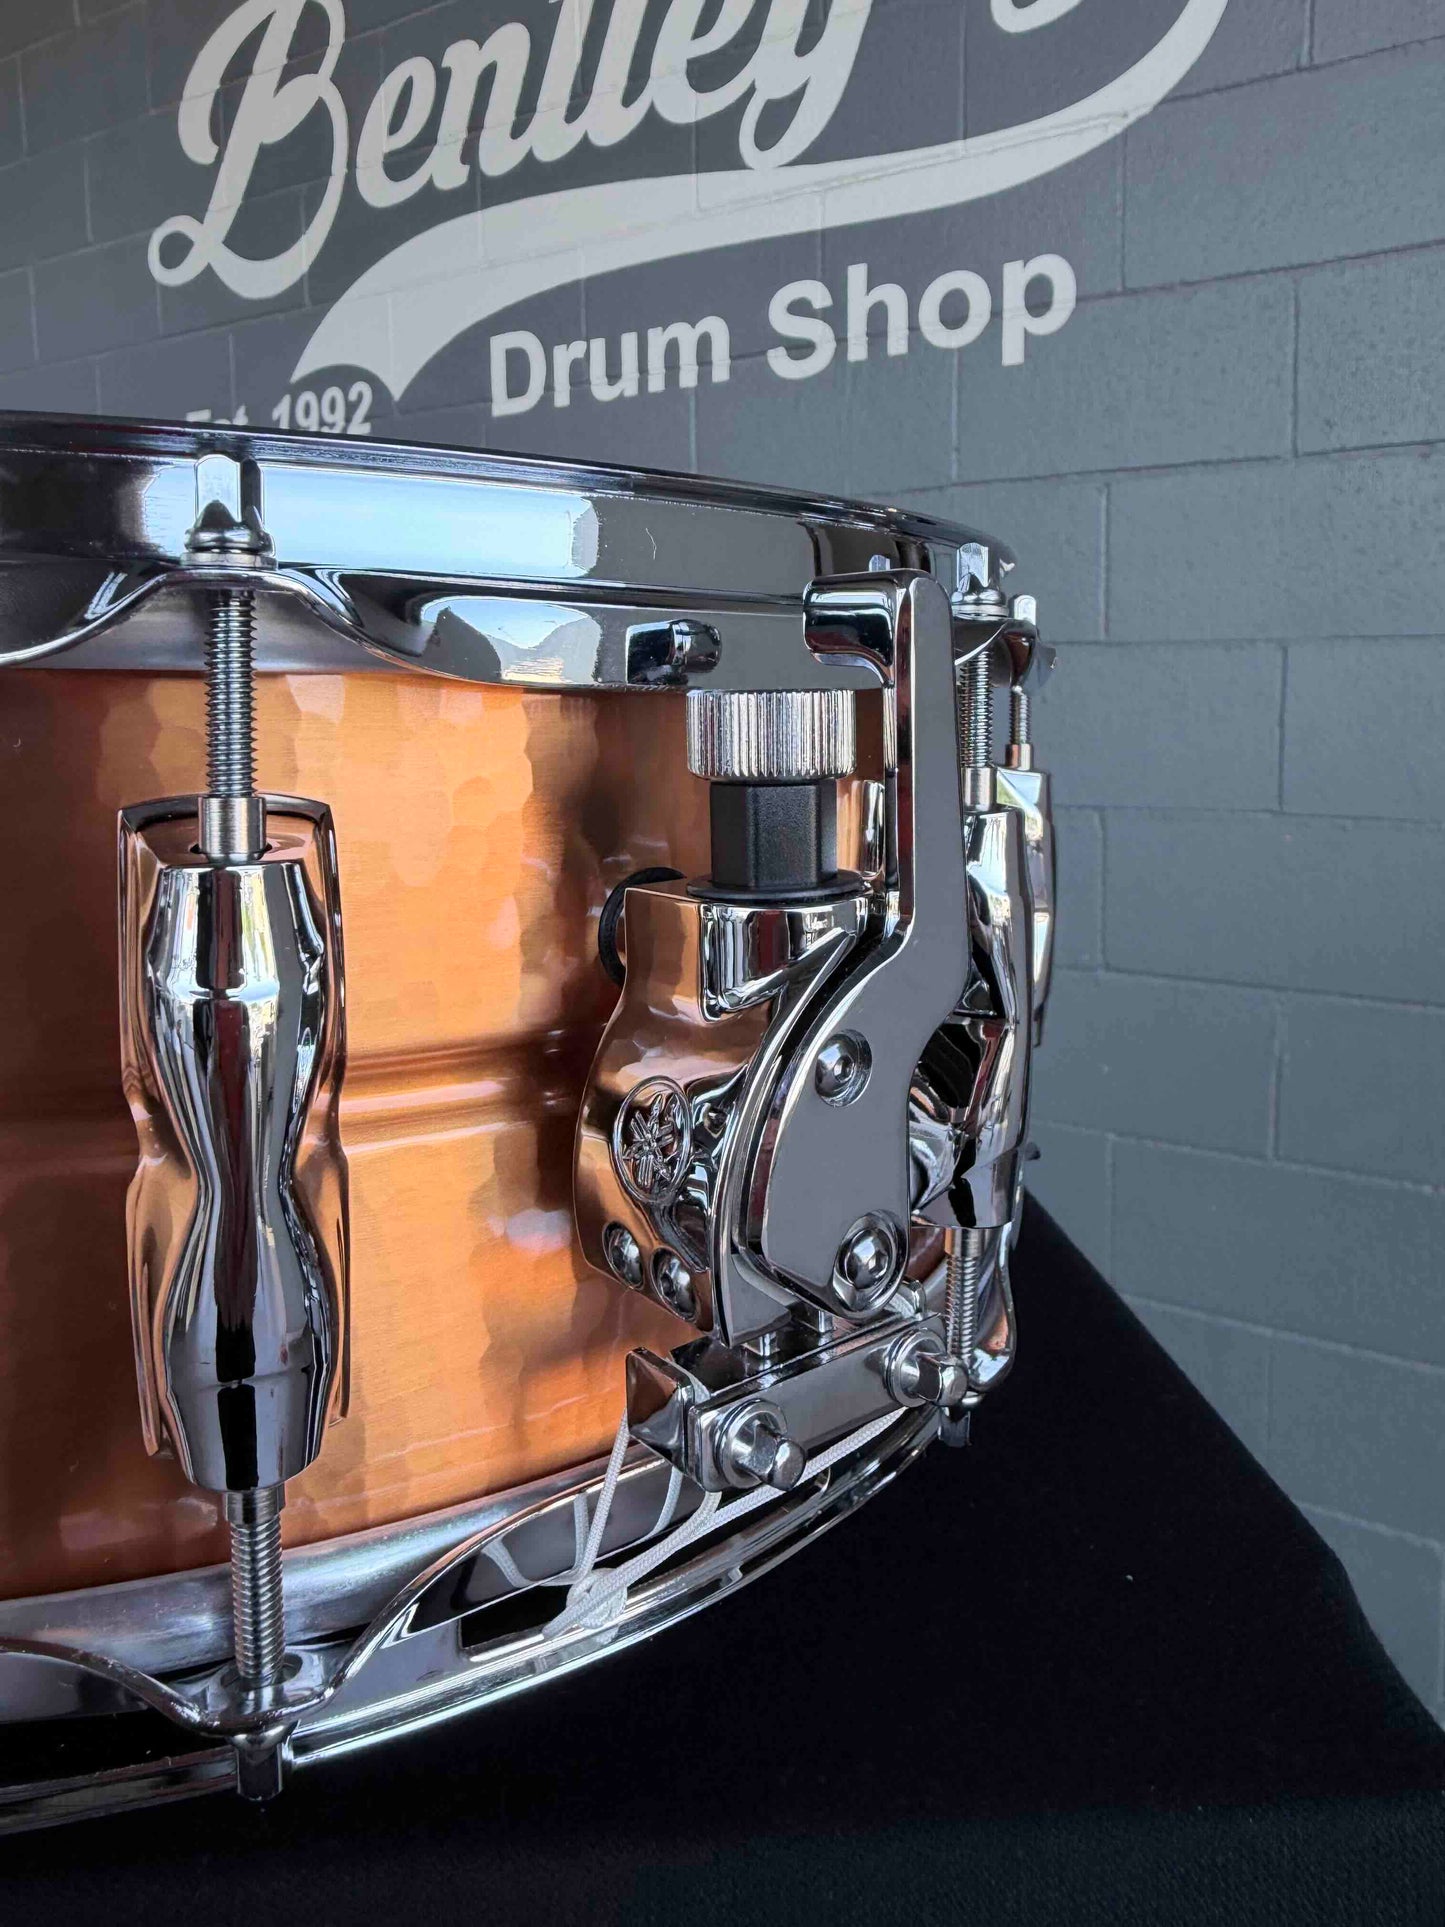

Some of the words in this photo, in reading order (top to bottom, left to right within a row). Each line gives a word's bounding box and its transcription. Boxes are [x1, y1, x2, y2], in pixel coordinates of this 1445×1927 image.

[148, 0, 1084, 299] Bentley
[271, 381, 373, 435] 1992
[490, 315, 731, 417] Drum
[767, 253, 1077, 380] Shop
